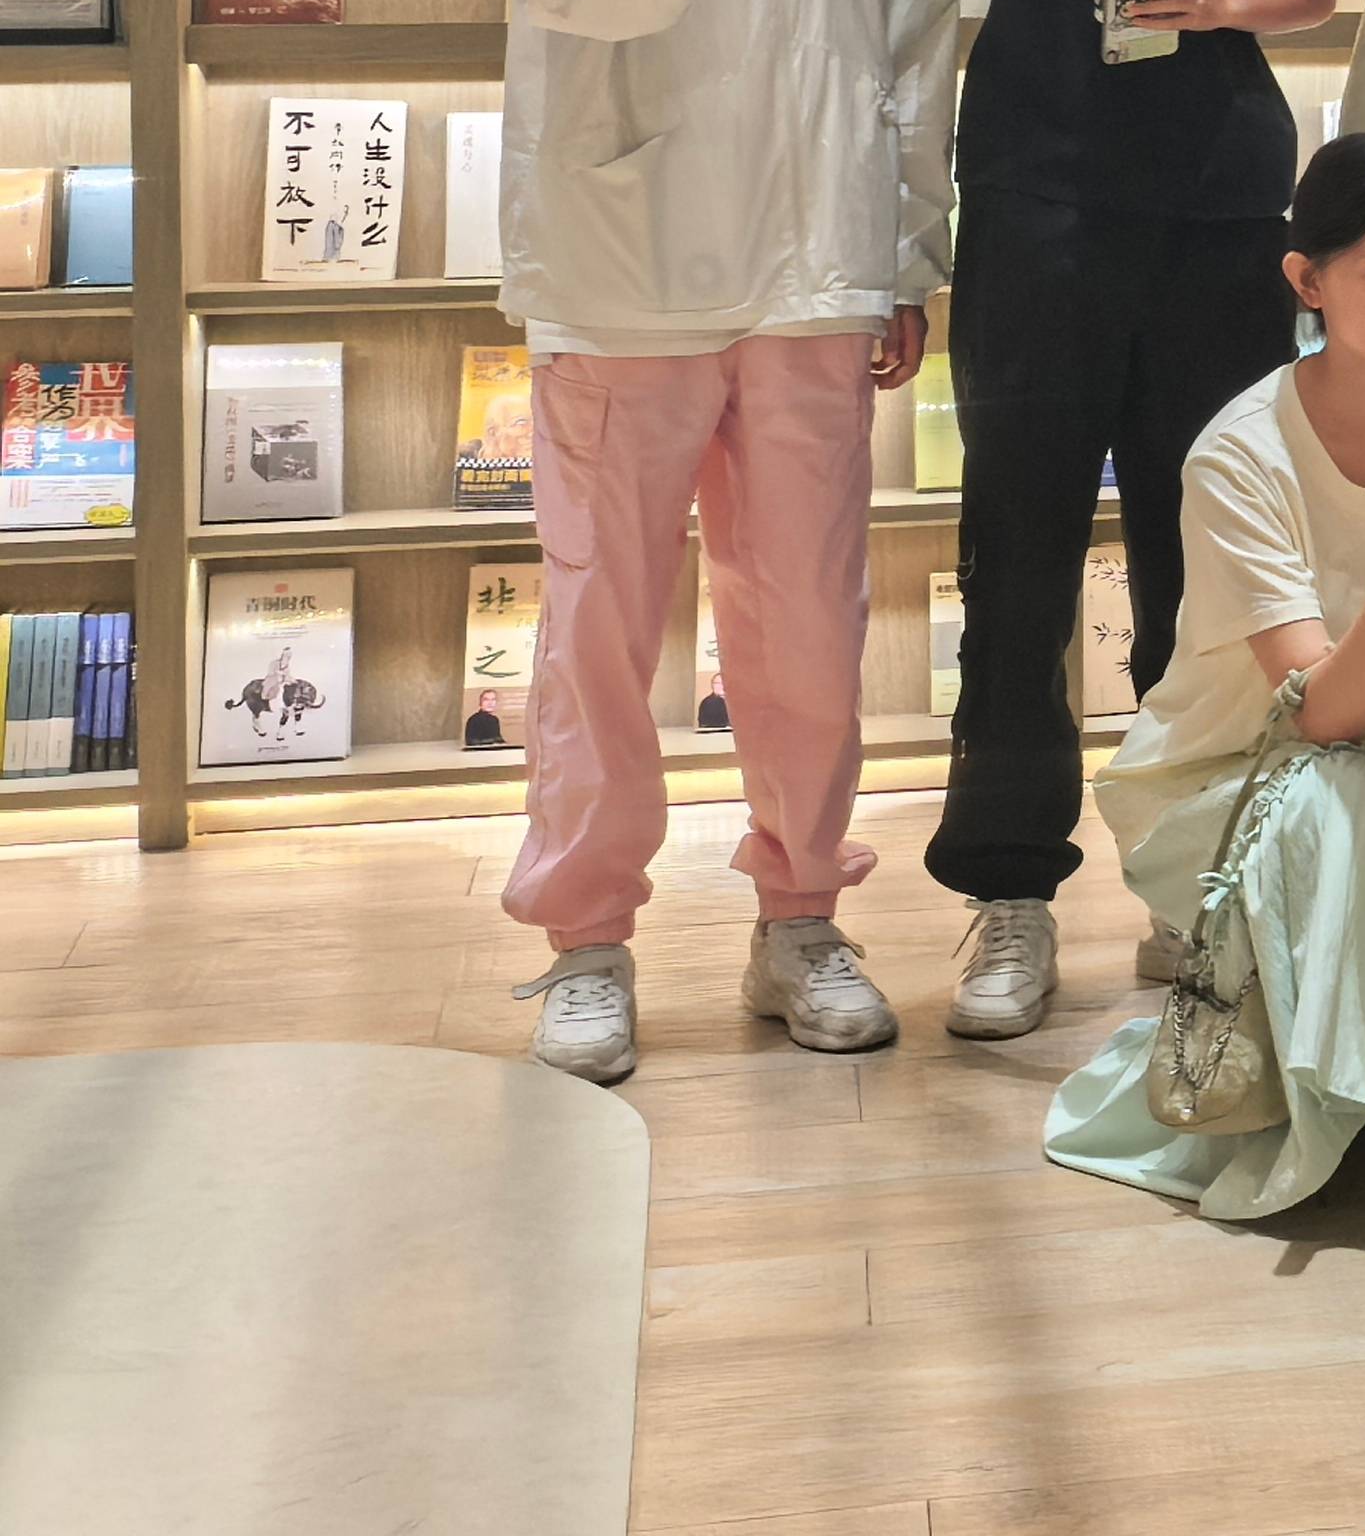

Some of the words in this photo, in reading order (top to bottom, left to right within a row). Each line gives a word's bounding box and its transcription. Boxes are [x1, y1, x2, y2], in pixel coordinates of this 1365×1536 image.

[276, 111, 316, 246] 不可放下
[361, 112, 393, 248] 人生没什么
